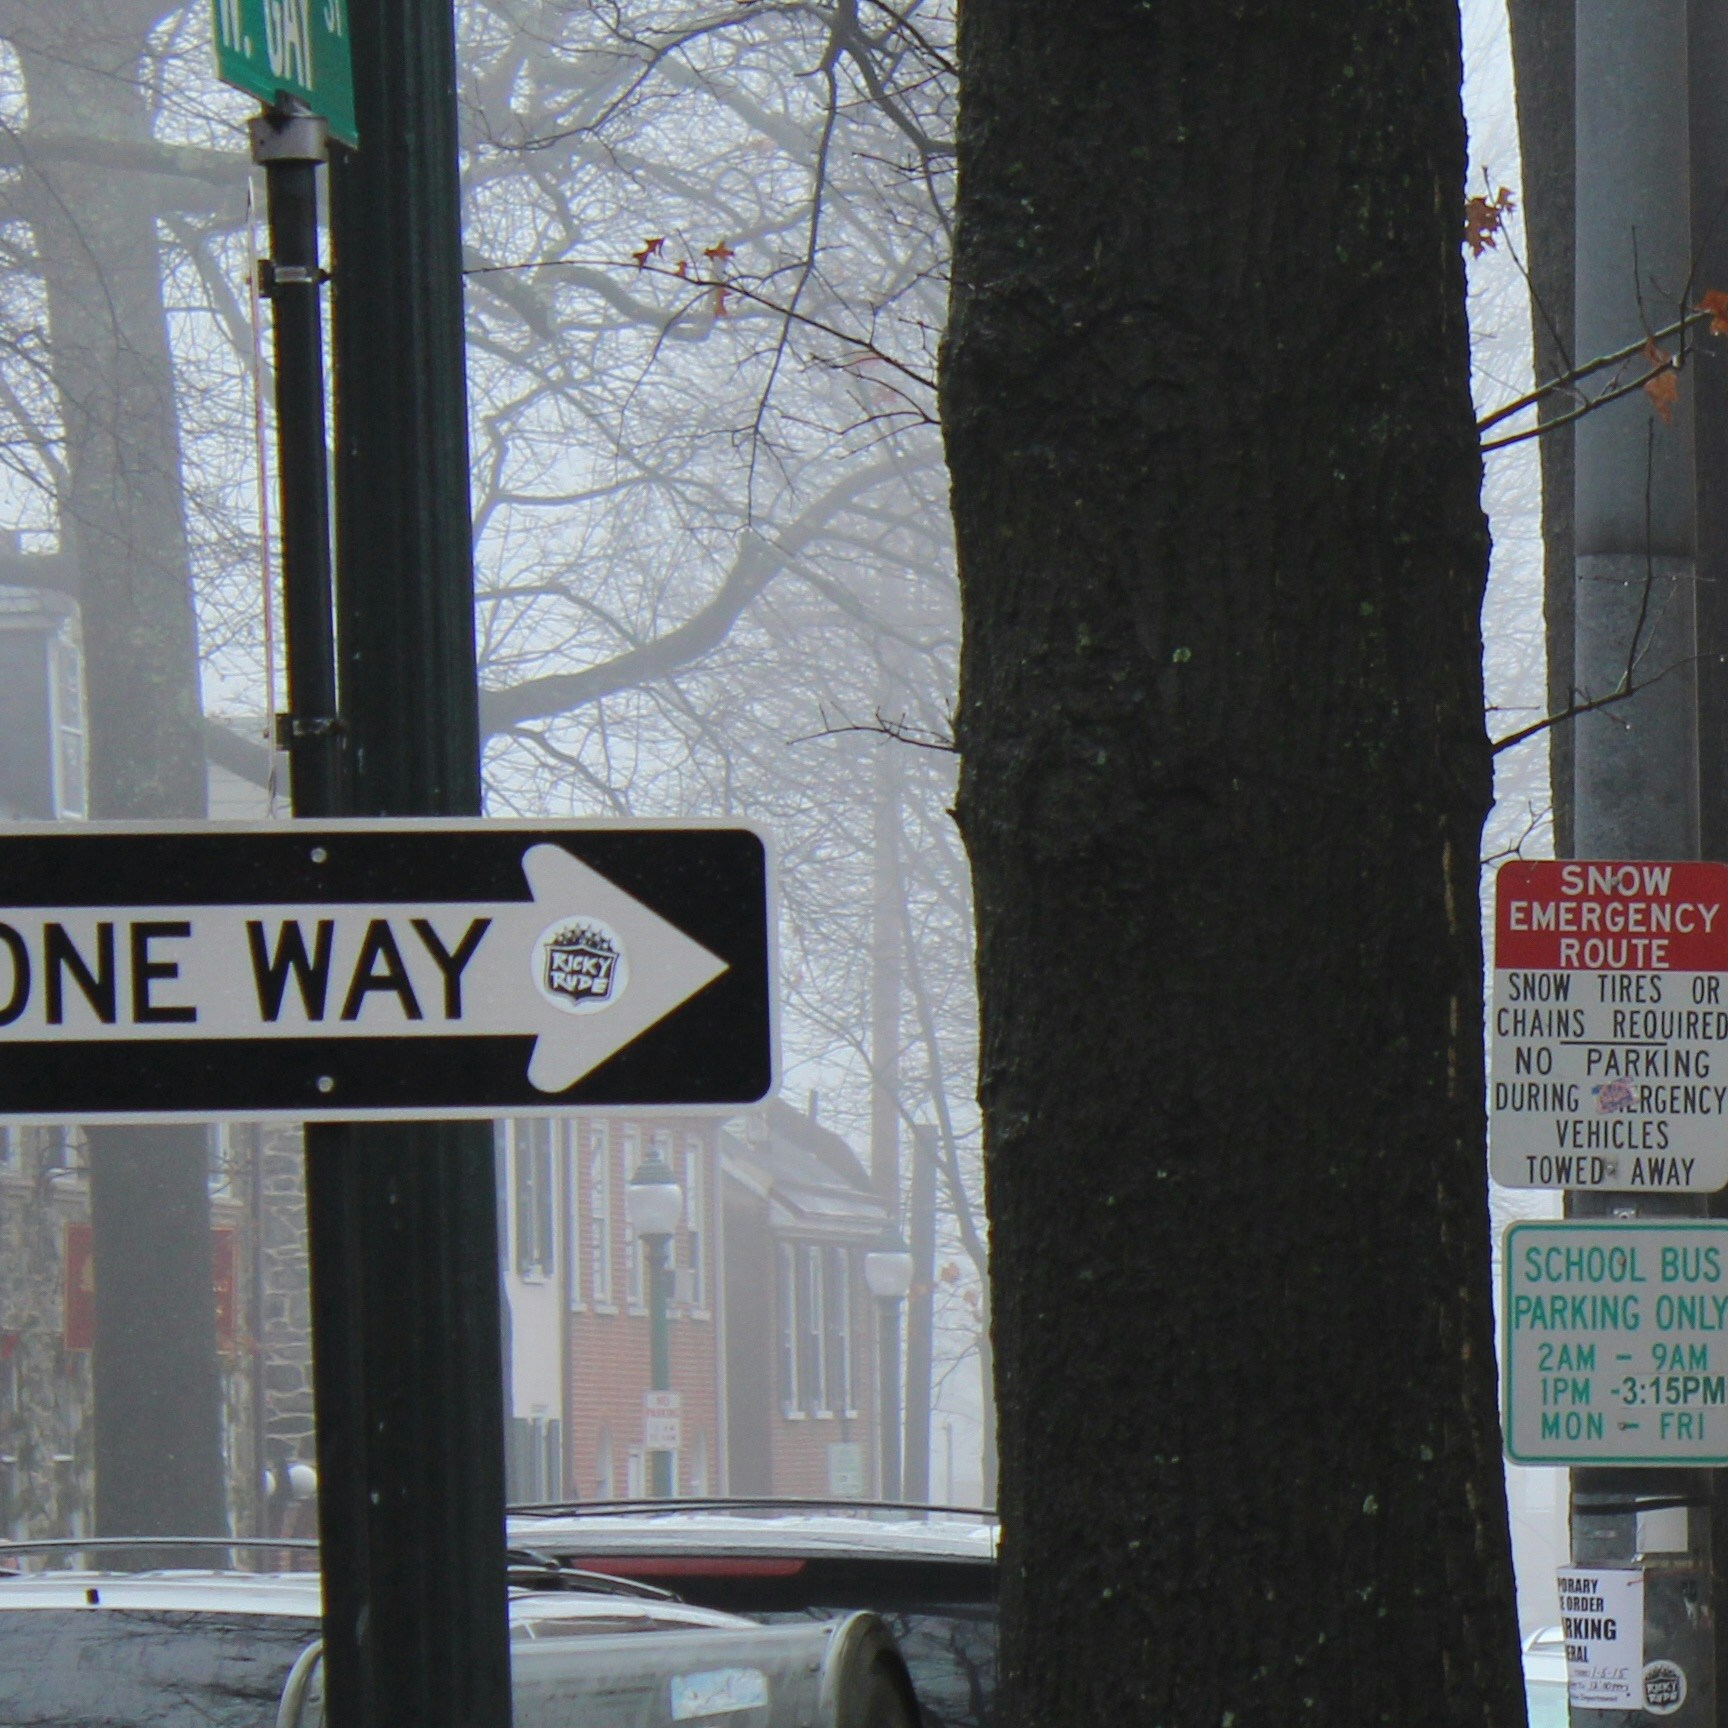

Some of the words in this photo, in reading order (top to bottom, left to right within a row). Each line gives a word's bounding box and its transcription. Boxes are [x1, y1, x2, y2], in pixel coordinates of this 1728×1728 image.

[1561, 864, 1673, 897] SNOW
[1509, 901, 1720, 933] EMERGENCY
[552, 951, 613, 978] RICKY
[1560, 938, 1670, 969] ROUTE
[246, 918, 493, 1022] WAY
[551, 970, 609, 994] RUDE
[1508, 972, 1571, 1003] SNOW
[1598, 974, 1662, 1004] TIRES
[1692, 975, 1720, 1005] OR
[1497, 1008, 1585, 1039] CHAINS
[1613, 1010, 1728, 1041] REQUIRED
[1515, 1047, 1552, 1076] NO
[1586, 1048, 1710, 1078] PARKING
[1496, 1082, 1579, 1113] DURING
[1598, 1085, 1728, 1115] ERGENCY
[1556, 1119, 1670, 1150] VEHICLES
[1526, 1155, 1604, 1185] TOWED
[1631, 1157, 1695, 1187] AWAY
[1525, 1246, 1647, 1283] SCHOOL
[1661, 1246, 1721, 1283] BUS
[1514, 1294, 1641, 1331] PARKING
[1538, 1343, 1596, 1372] 2AM
[1652, 1343, 1708, 1372] 9AM
[1540, 1378, 1591, 1405] 1PM
[1541, 1411, 1603, 1441] MON
[1660, 1412, 1705, 1440] FRI
[1566, 1596, 1604, 1613] ORDER
